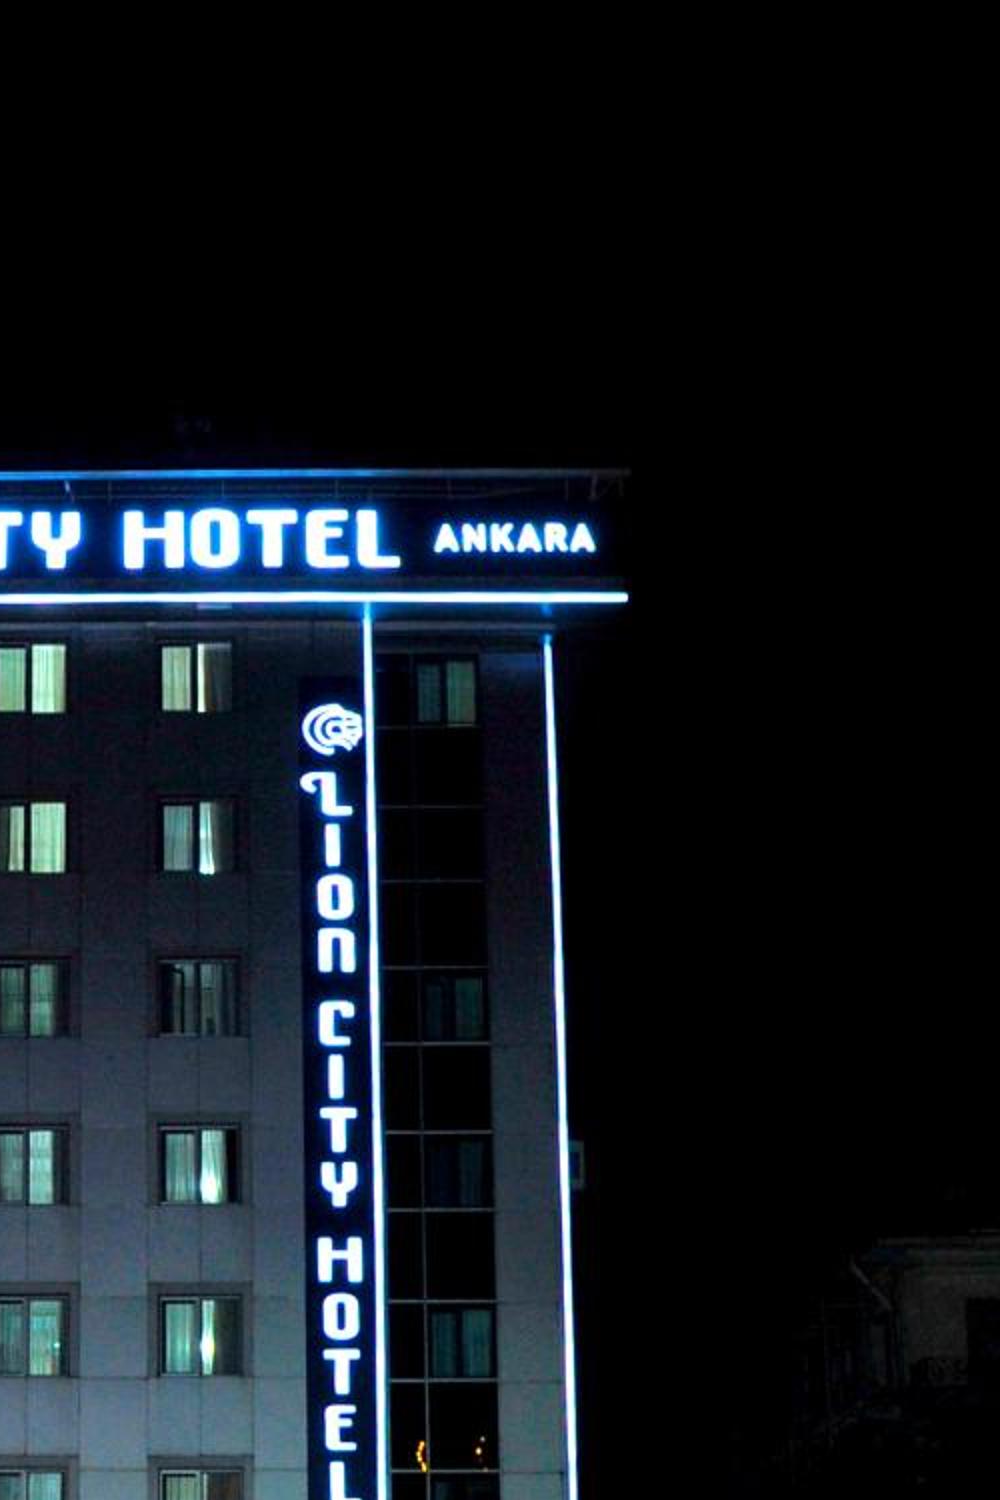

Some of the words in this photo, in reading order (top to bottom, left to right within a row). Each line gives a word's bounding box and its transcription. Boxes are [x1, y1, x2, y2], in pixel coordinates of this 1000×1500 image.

[118, 506, 401, 572] HOTEL
[433, 521, 595, 553] ANKARA
[300, 771, 356, 973] LION
[318, 1000, 358, 1208] CITY
